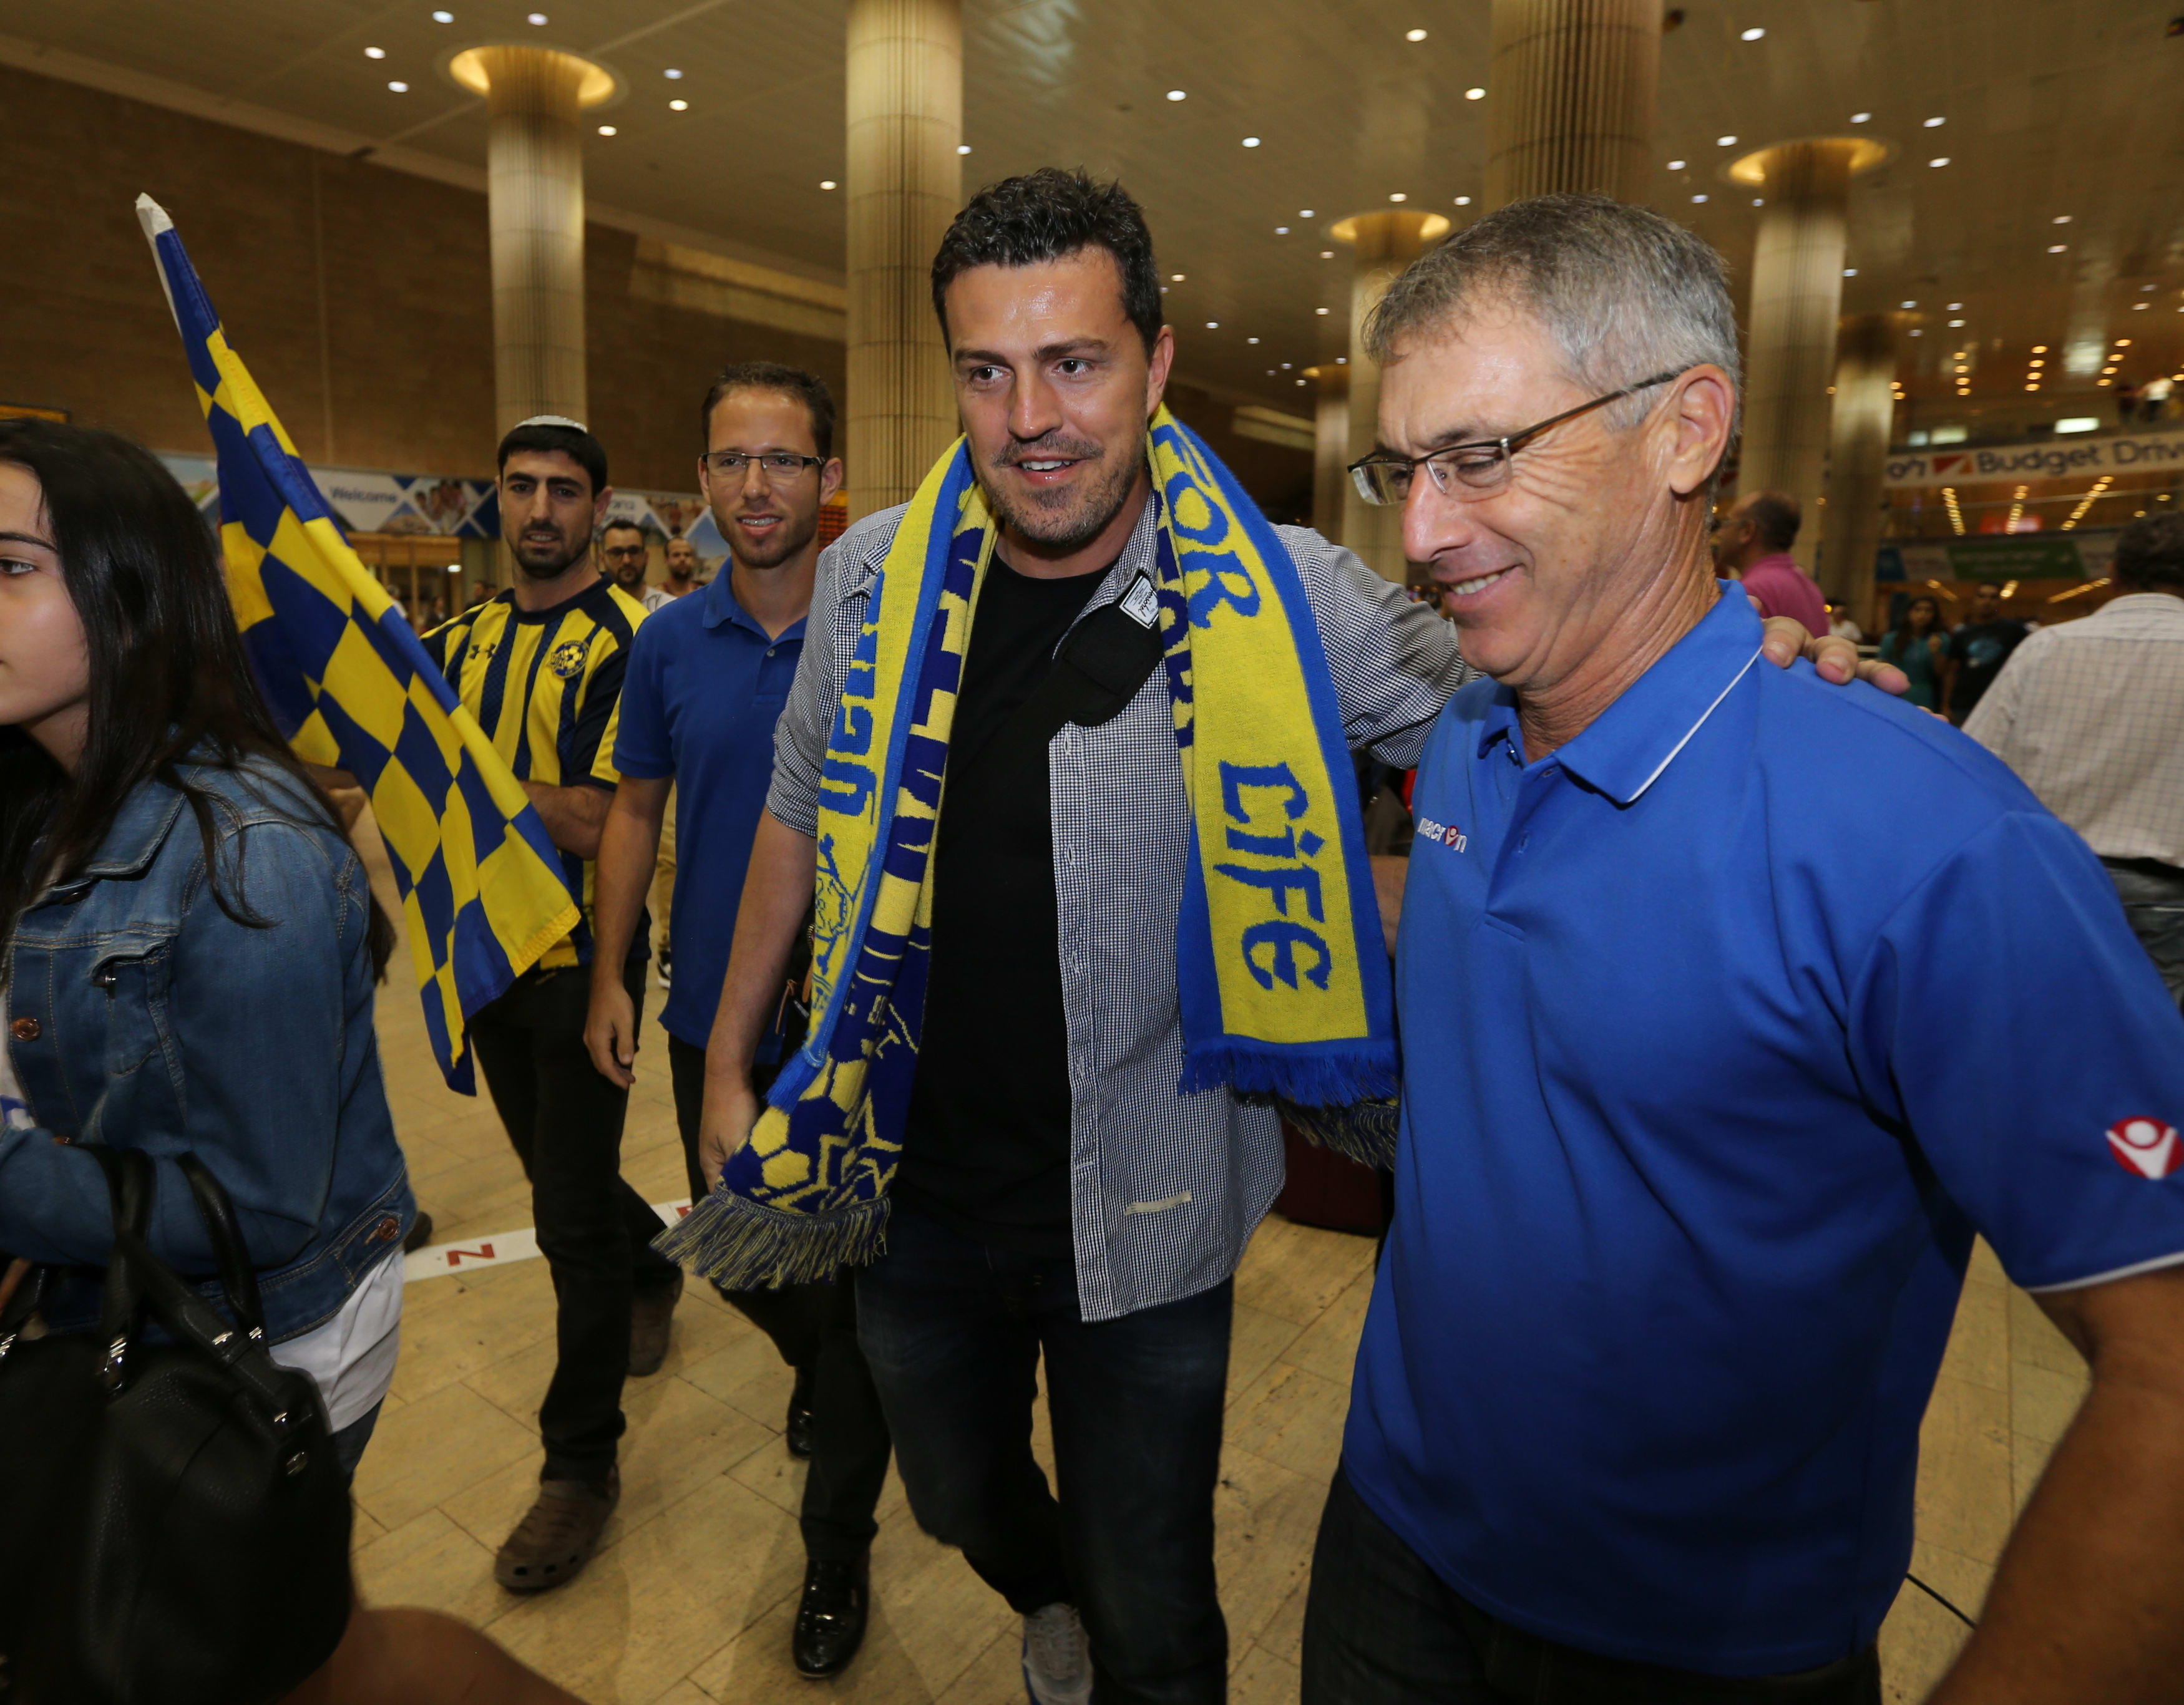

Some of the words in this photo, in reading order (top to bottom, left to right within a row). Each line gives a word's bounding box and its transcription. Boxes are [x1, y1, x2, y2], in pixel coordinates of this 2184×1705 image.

[1977, 443, 2102, 476] Budget
[331, 485, 397, 503] Welcome
[1152, 424, 1261, 629] FOR
